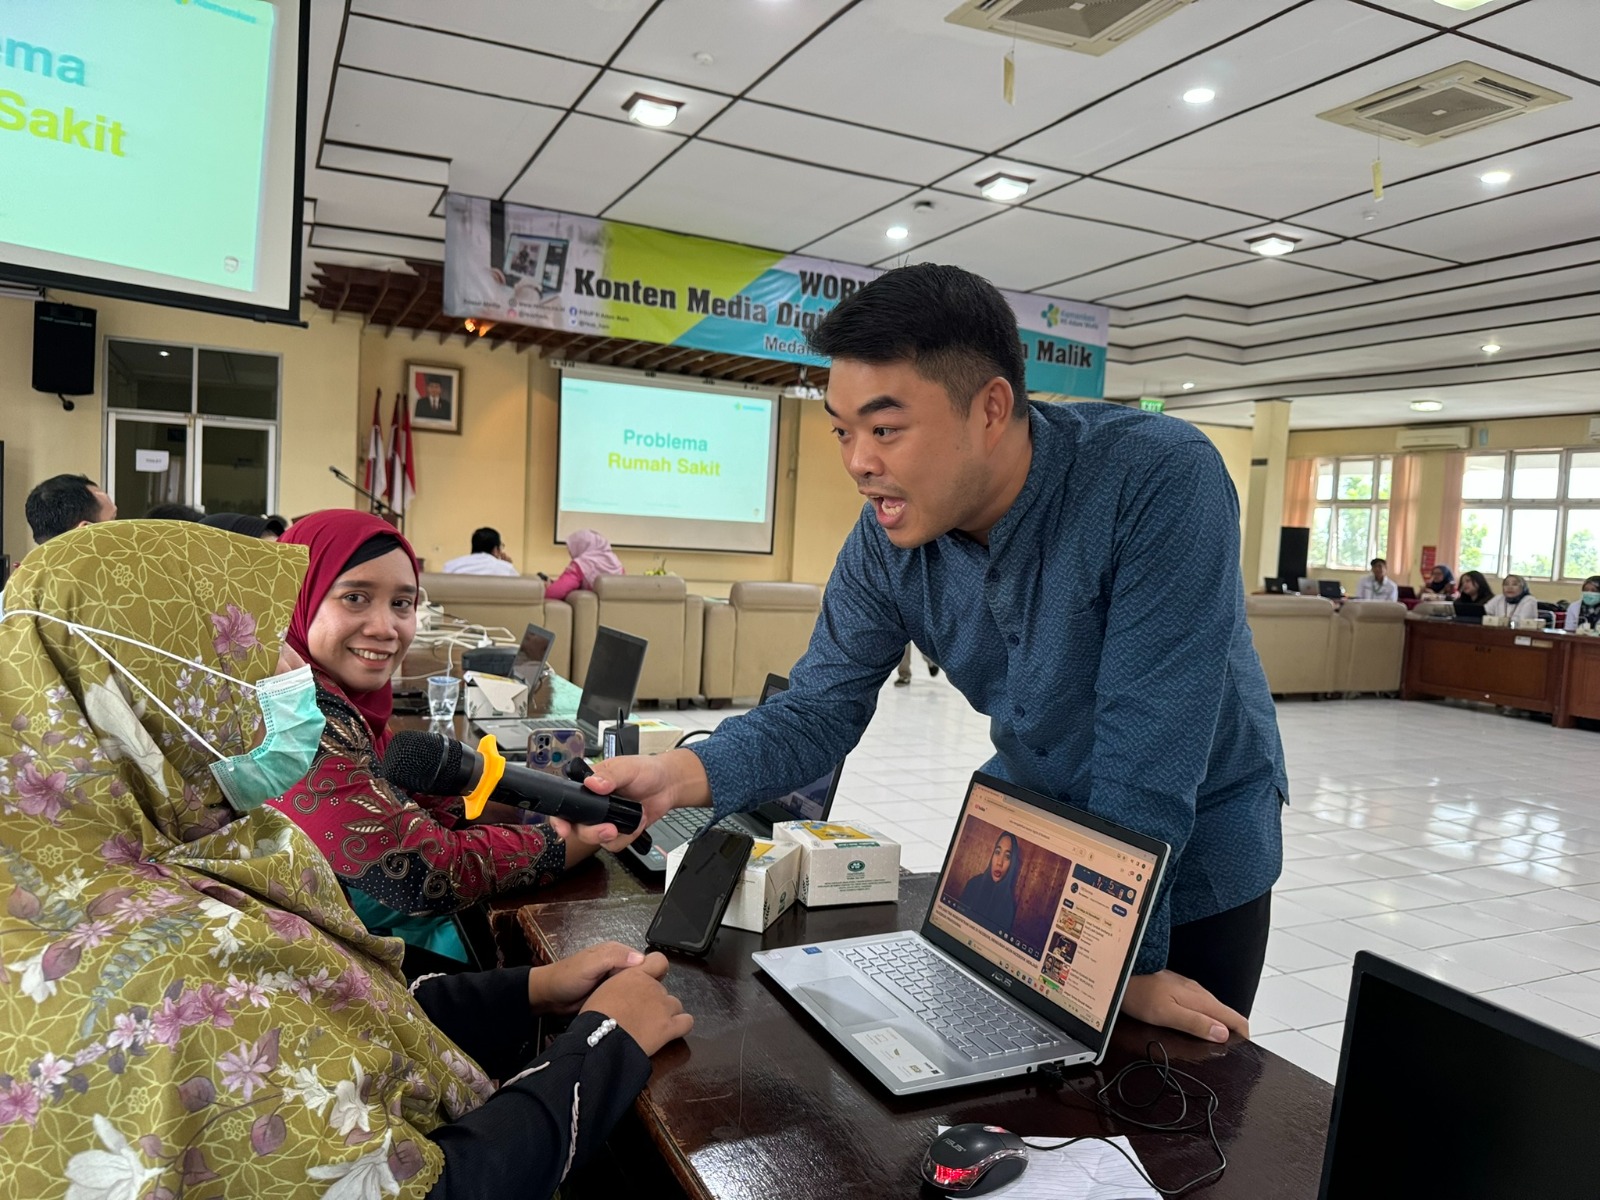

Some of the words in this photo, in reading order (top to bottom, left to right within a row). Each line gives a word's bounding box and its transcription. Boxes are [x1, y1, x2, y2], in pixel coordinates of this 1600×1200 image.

[0, 38, 86, 87] ma
[0, 88, 127, 158] Sakit
[574, 267, 677, 310] Konten
[687, 287, 768, 324] Media
[799, 270, 866, 300] WOR
[1037, 340, 1093, 368] Malik
[623, 428, 708, 452] Problema
[607, 451, 672, 473] Rumah
[676, 457, 721, 477] Sakit
[942, 1137, 967, 1152] ASUS
